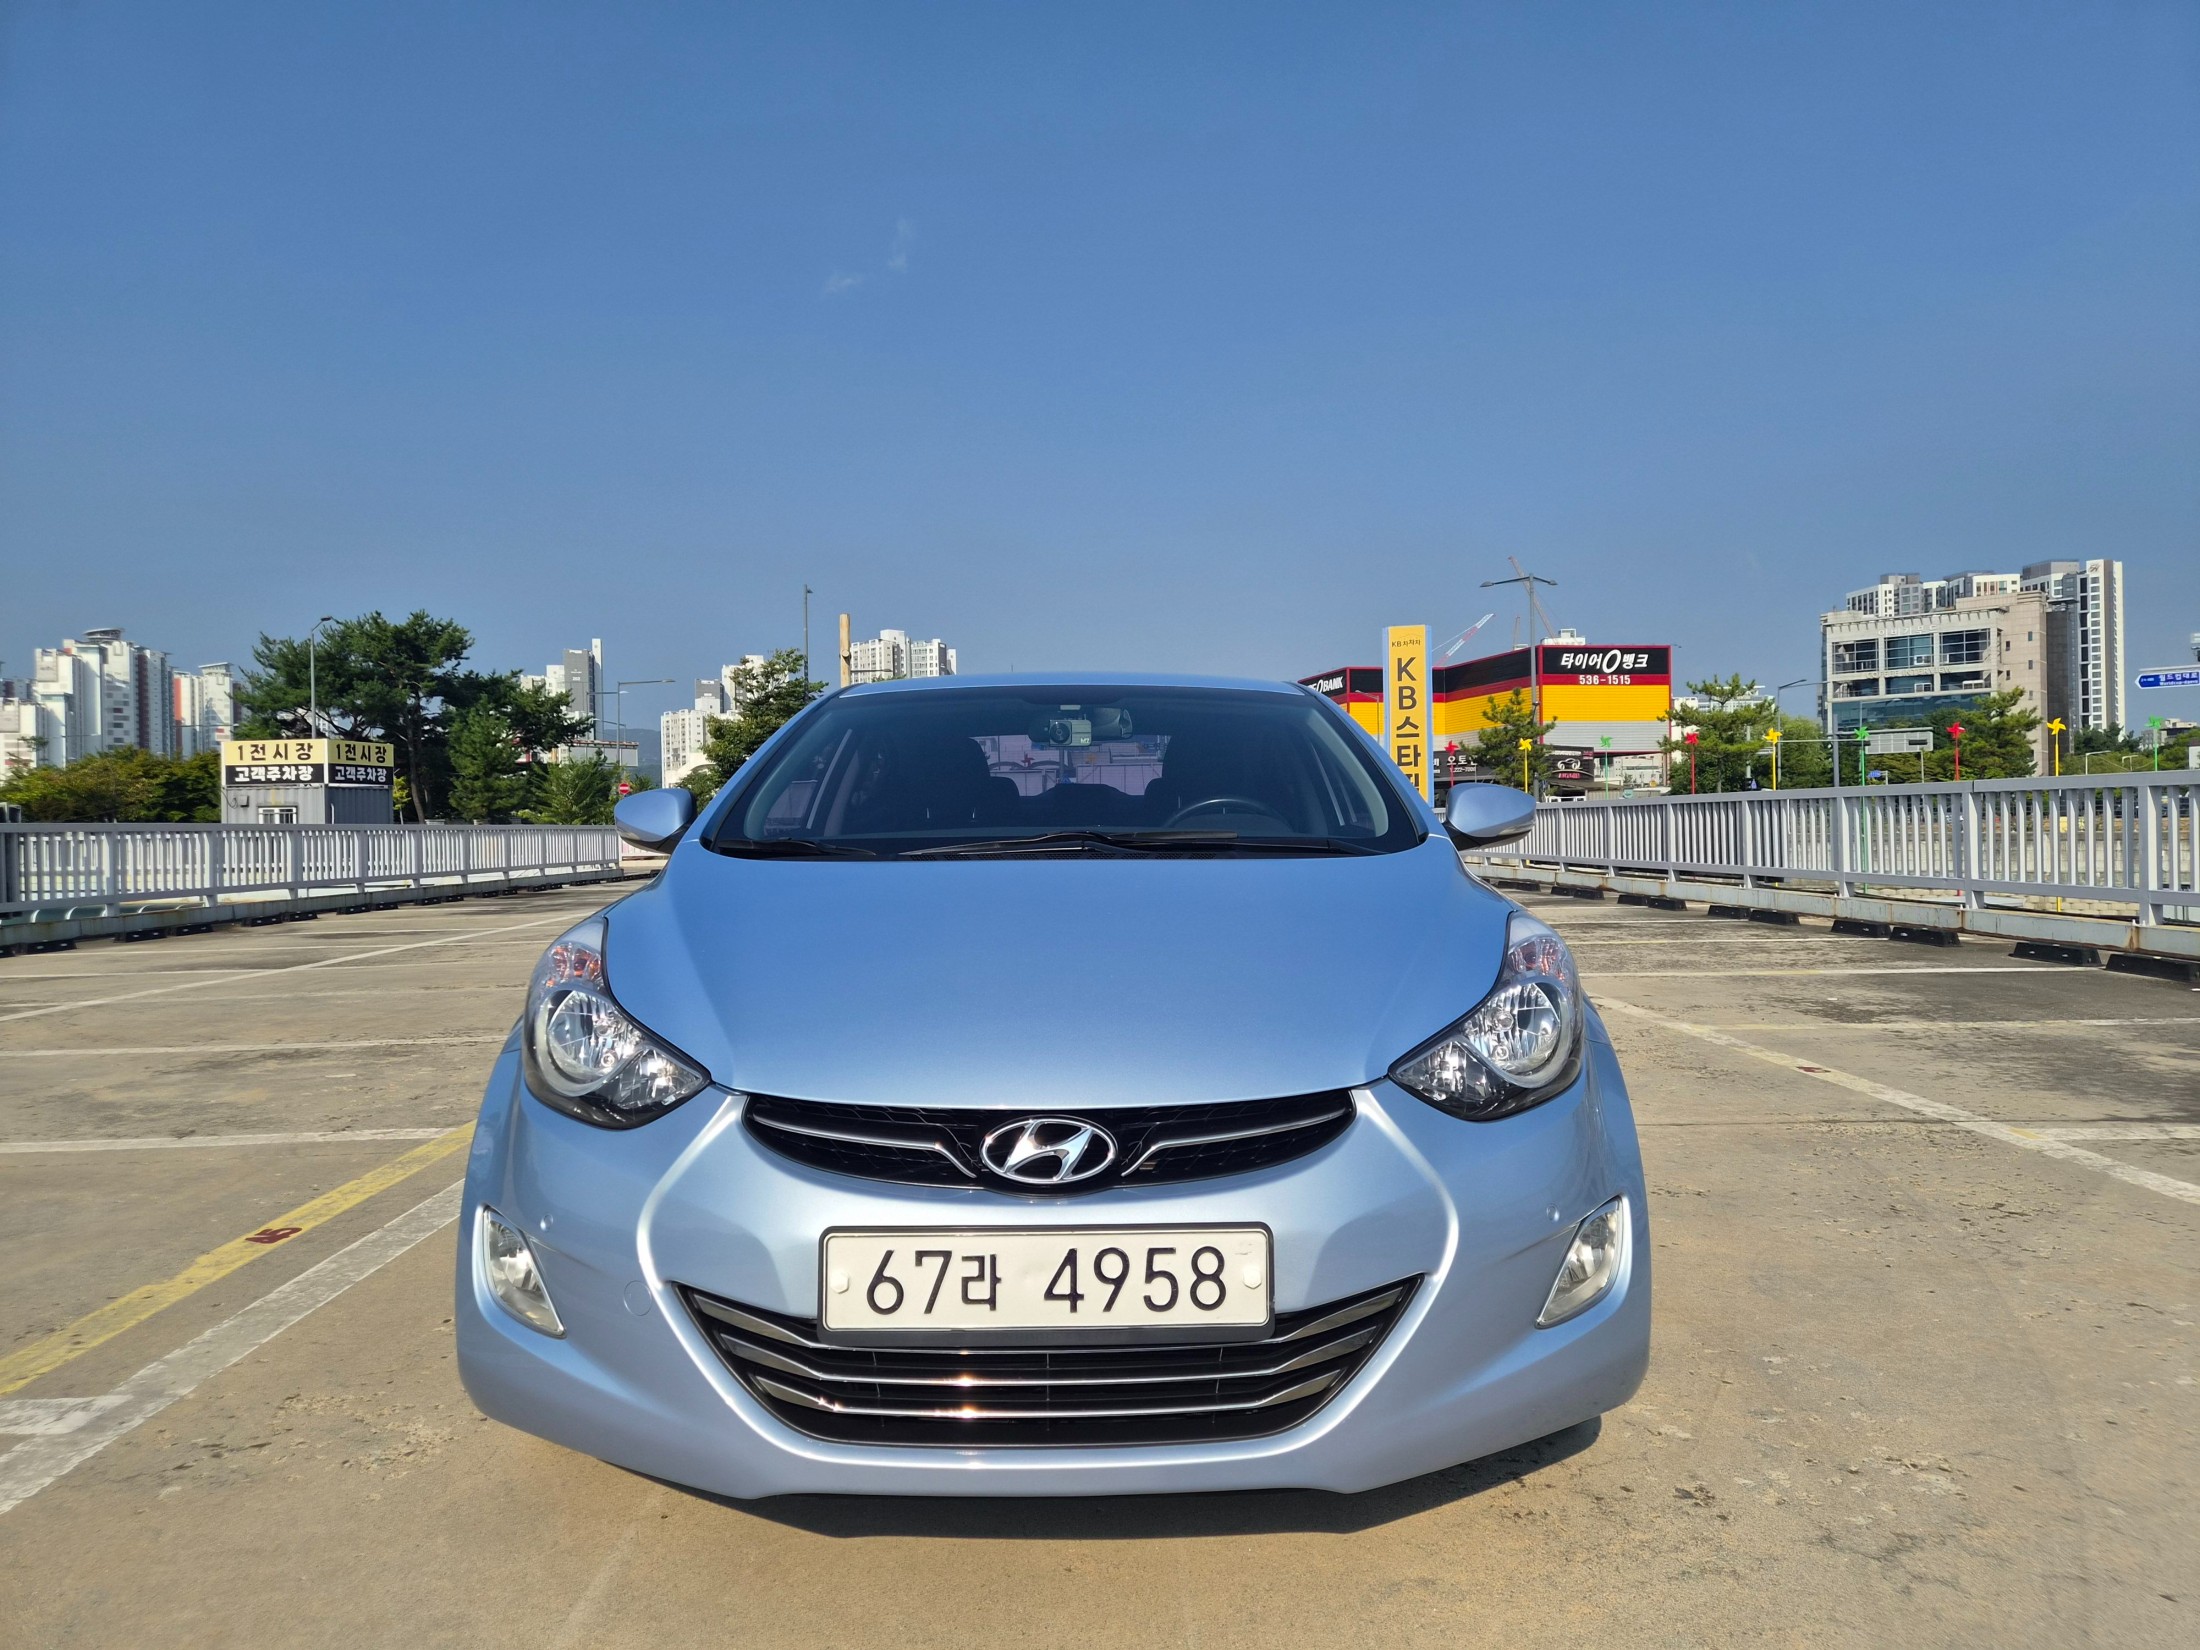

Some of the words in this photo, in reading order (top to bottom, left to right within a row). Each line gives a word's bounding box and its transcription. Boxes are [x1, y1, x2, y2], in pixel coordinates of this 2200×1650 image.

[1402, 639, 1421, 647] 차차차
[1579, 675, 1631, 685] 536-1515
[234, 765, 313, 782] 고객주차장
[335, 765, 387, 783] 고객주차장
[866, 1249, 1002, 1315] 67라
[1043, 1245, 1228, 1314] 4958
